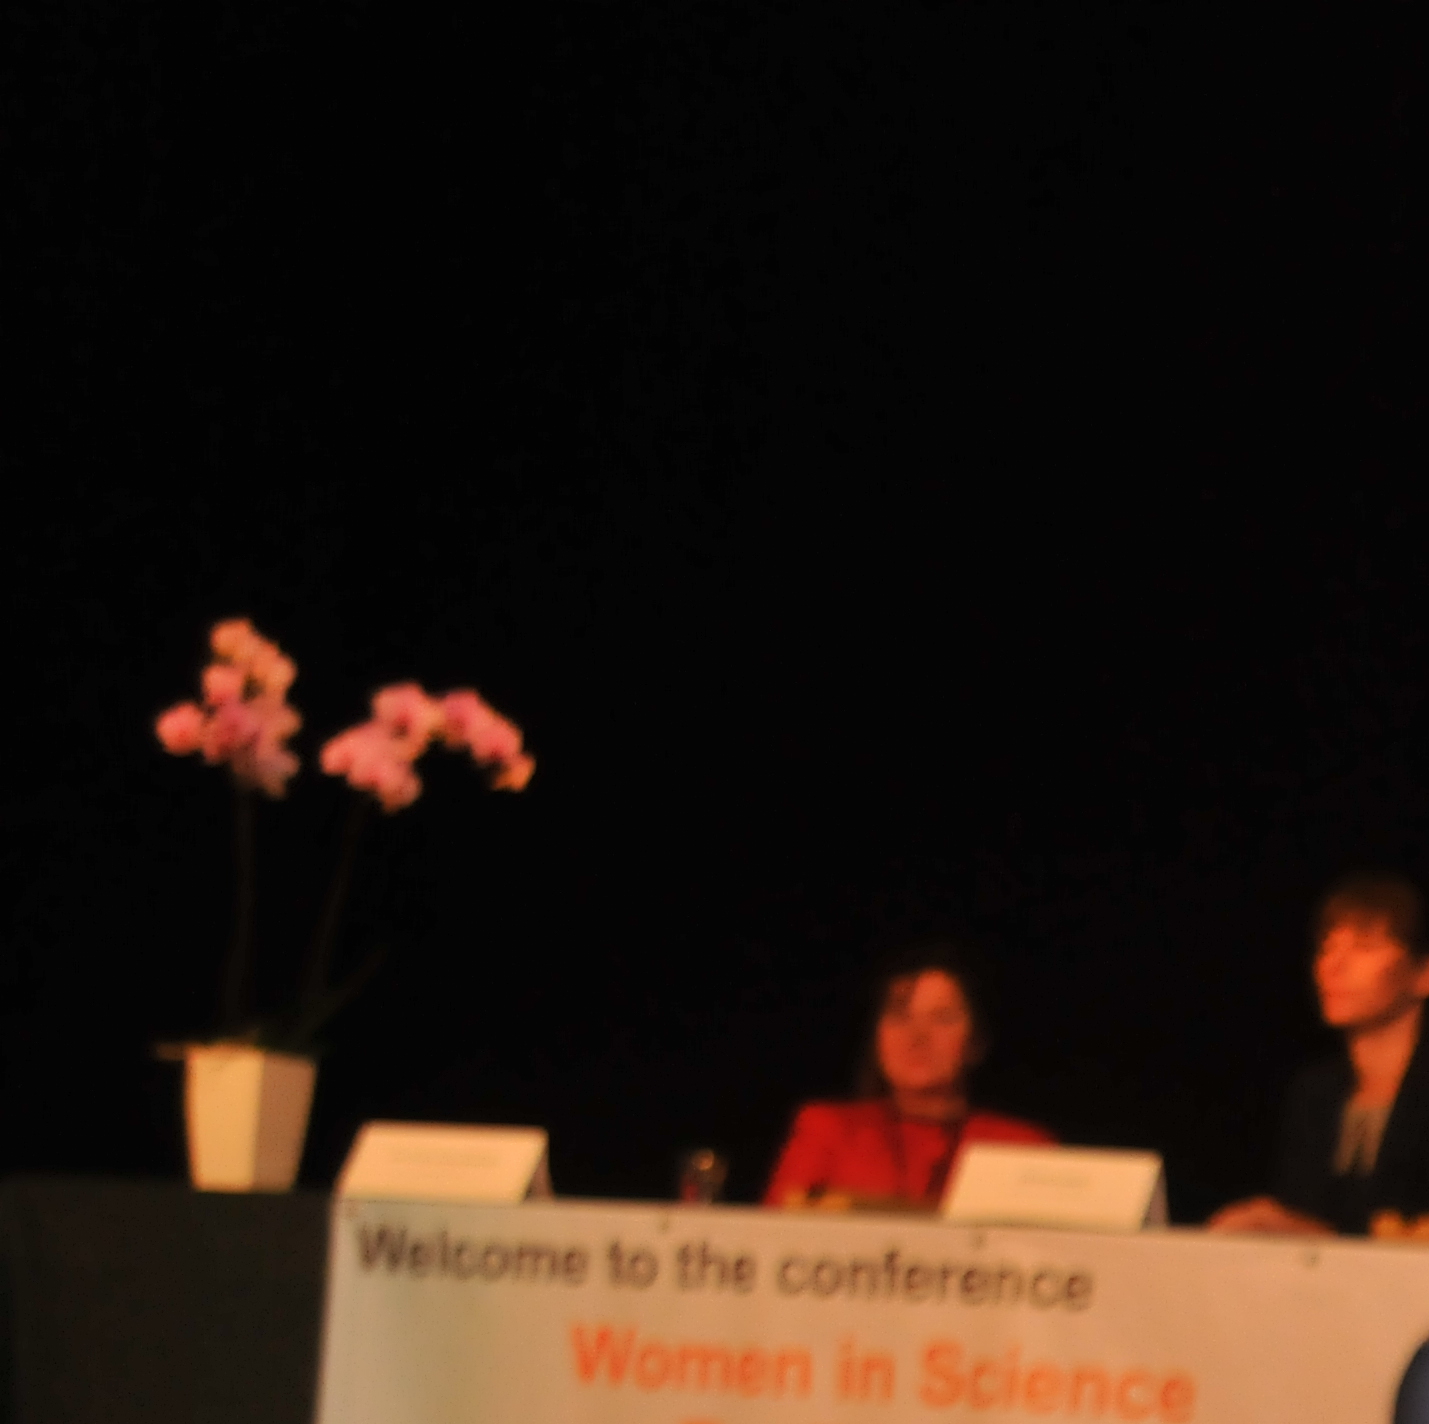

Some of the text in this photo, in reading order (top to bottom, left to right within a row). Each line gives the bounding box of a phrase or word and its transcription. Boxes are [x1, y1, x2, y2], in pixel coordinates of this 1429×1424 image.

[356, 1222, 1094, 1312] Welcome to the conference
[569, 1324, 1197, 1424] Women in Science
